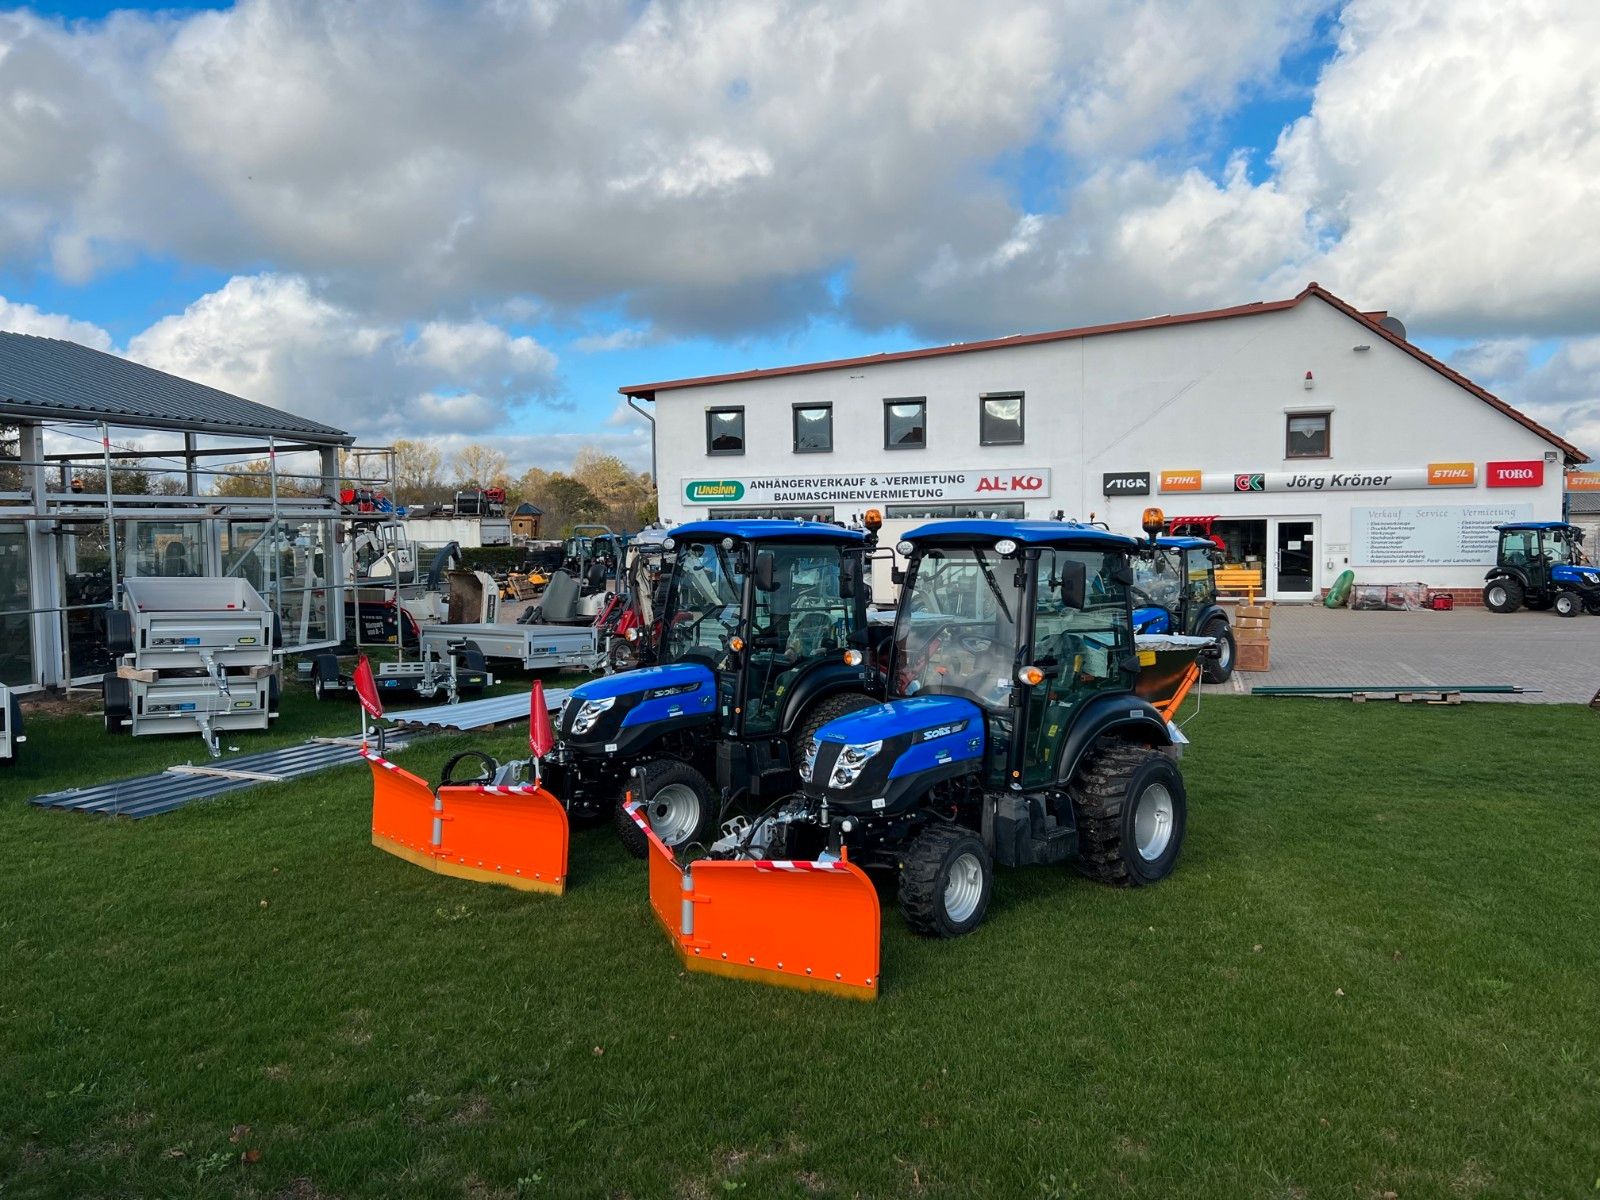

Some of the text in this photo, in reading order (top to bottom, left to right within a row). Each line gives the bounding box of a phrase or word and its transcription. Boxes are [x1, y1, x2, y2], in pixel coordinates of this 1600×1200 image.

[1432, 469, 1469, 478] STIHL
[1496, 469, 1532, 479] TORO
[750, 477, 866, 489] ANHÄNGERVERKAUF
[870, 477, 878, 486] &
[976, 475, 1043, 492] AL-KO
[1106, 478, 1147, 489] STIGA
[1165, 476, 1197, 485] STIHL
[1286, 474, 1392, 489] Jörg Kröner
[774, 488, 943, 501] BAUMASCHINENVERMIETUNG
[1368, 508, 1516, 520] Verkauf Service Vermietung
